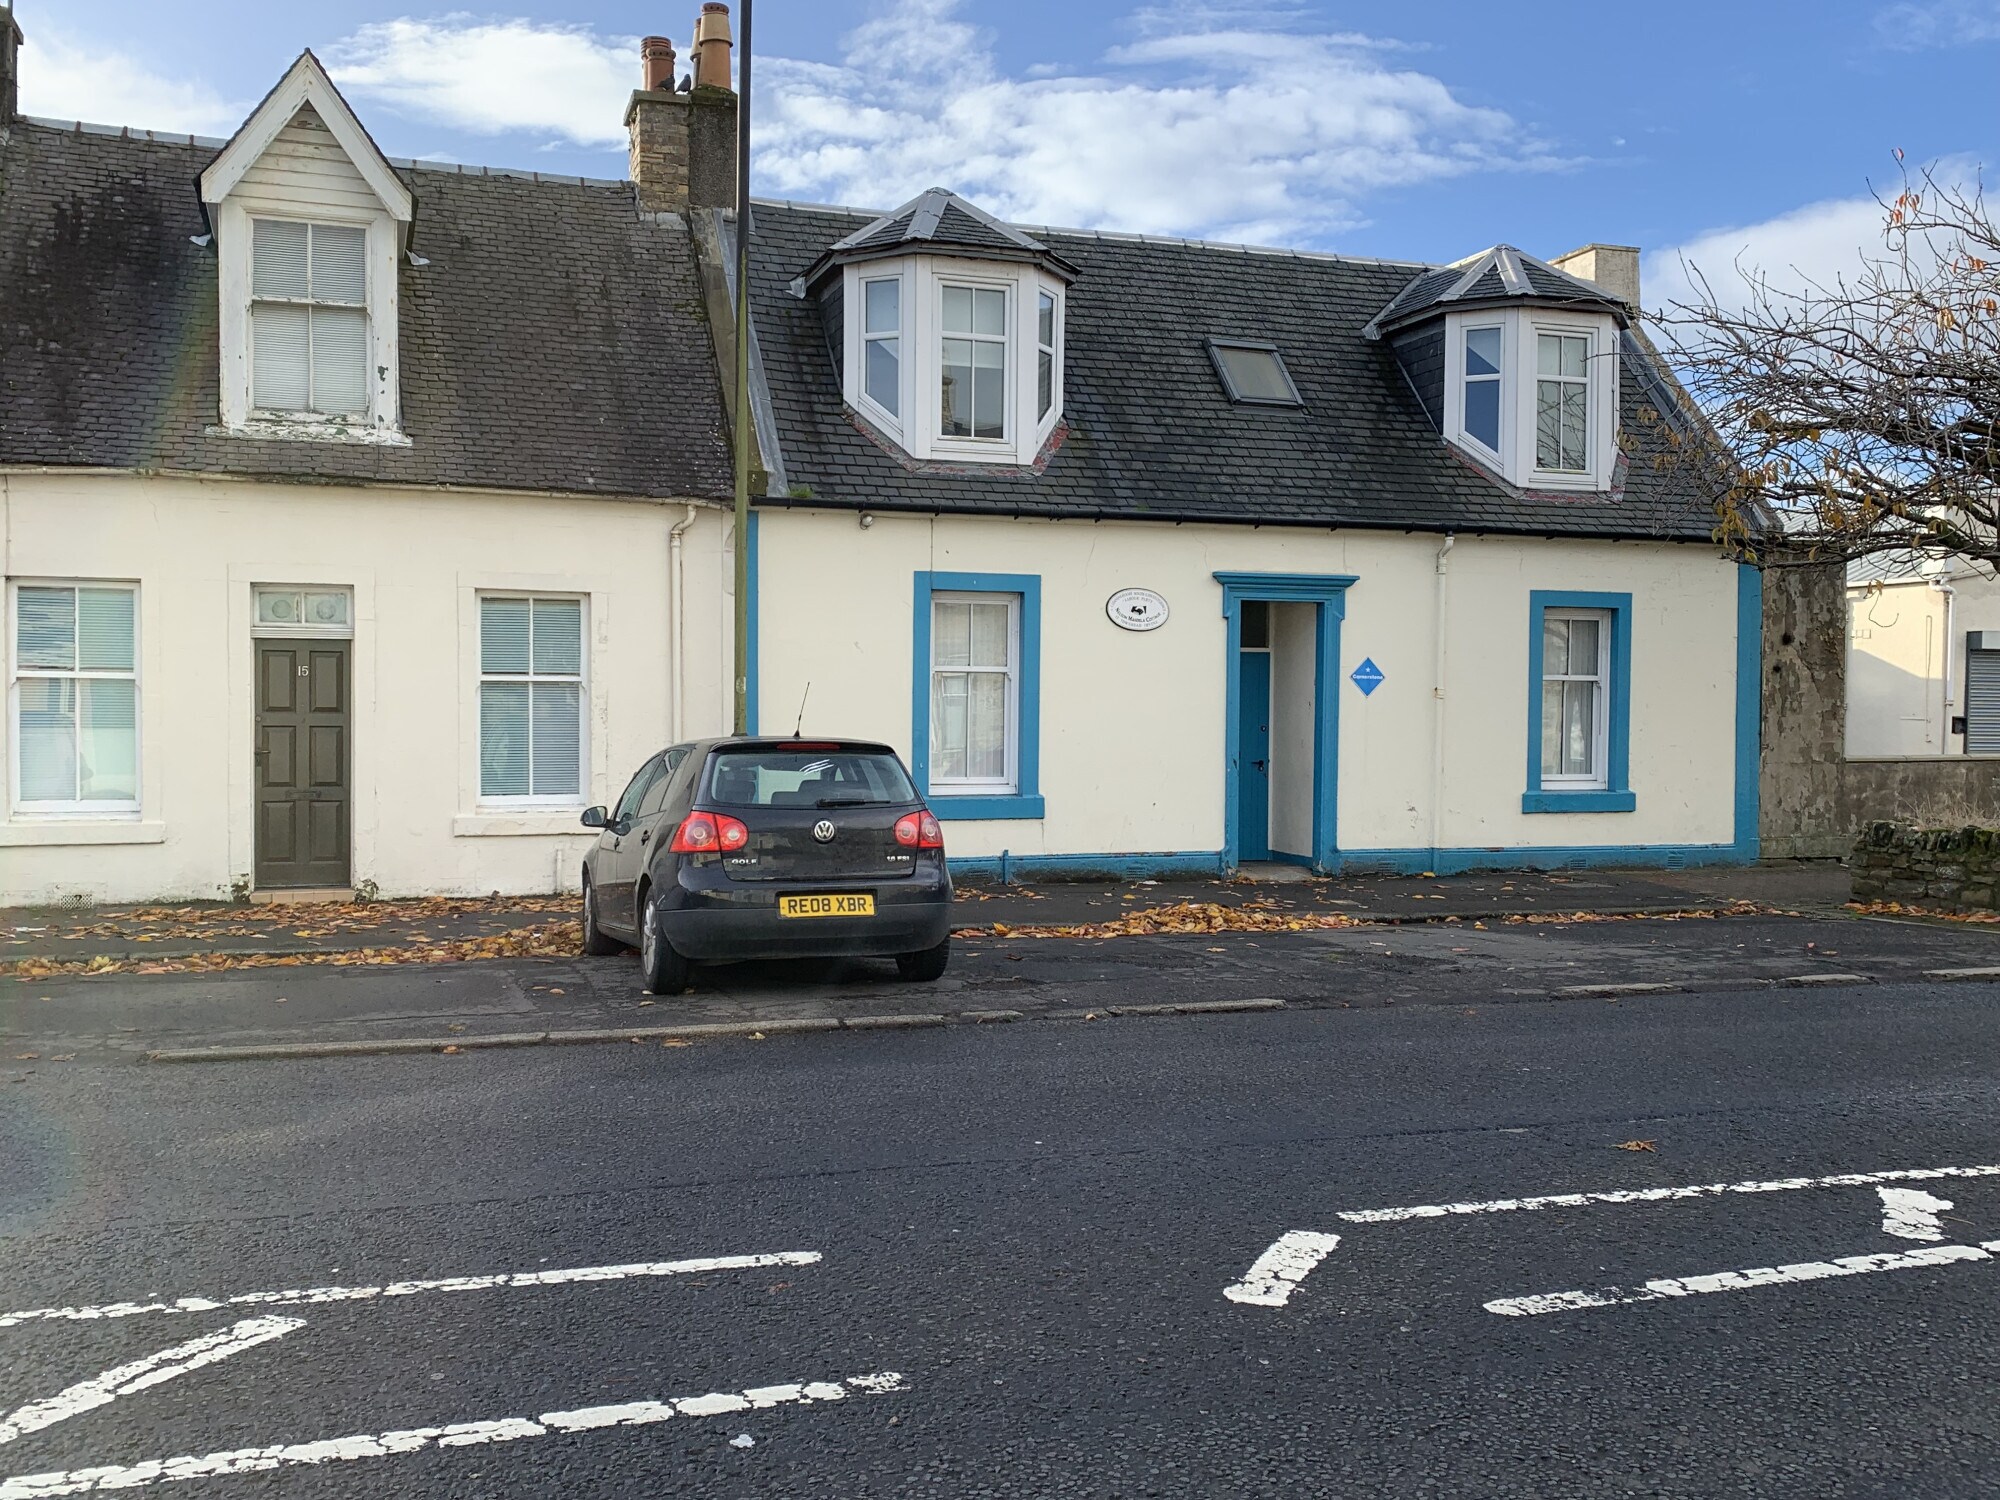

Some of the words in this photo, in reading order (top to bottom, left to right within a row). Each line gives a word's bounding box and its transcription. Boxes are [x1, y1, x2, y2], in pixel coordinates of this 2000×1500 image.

[1128, 615, 1146, 623] MANDELA
[298, 665, 309, 677] 15
[788, 897, 832, 914] RE08
[836, 896, 867, 912] XBR
